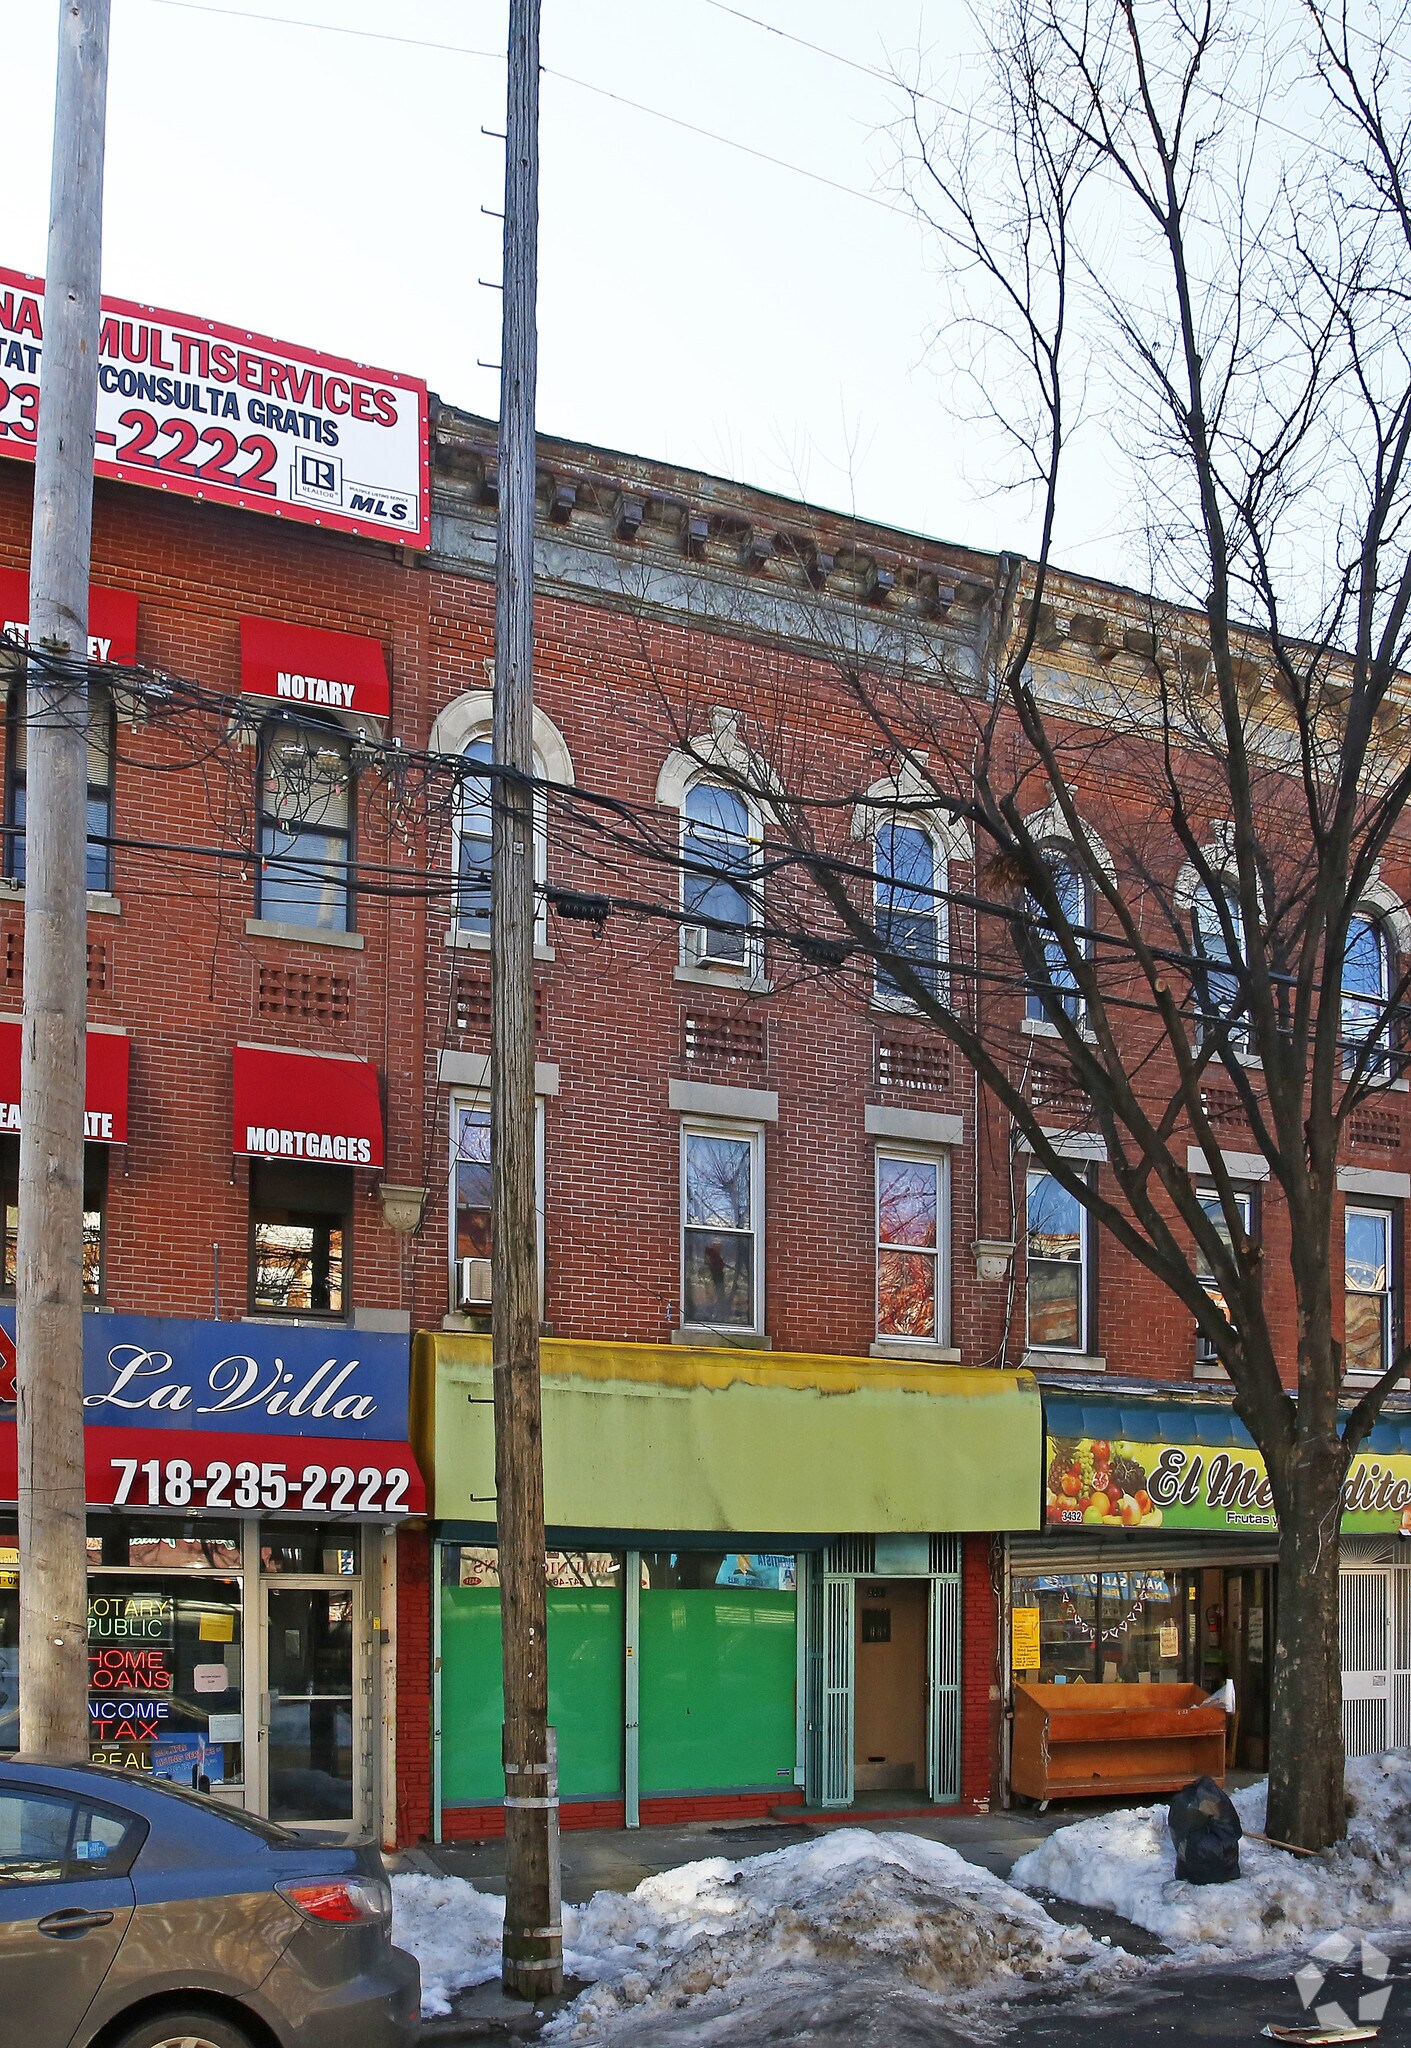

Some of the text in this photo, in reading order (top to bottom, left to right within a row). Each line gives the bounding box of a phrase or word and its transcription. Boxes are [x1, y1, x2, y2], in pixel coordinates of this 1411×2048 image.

[99, 317, 399, 428] MULTISERVICES
[99, 364, 241, 422] CONSULTA
[247, 399, 340, 447] GRATIS
[302, 485, 335, 499] REALTOR
[371, 491, 389, 499] LISTING
[390, 495, 409, 503] SERVICE
[349, 493, 409, 520] MLS
[277, 671, 355, 708] NOTARY
[246, 1125, 372, 1164] MORTGAGES
[83, 1343, 378, 1421] La Villa
[110, 1458, 411, 1513] 718-235-2222
[1146, 1448, 1204, 1508] El
[1061, 1510, 1083, 1523] 3432
[1226, 1511, 1270, 1525] Frutas
[87, 1617, 163, 1638] PUBLIC
[88, 1669, 171, 1689] OANS
[88, 1702, 169, 1719] NCOME
[91, 1720, 159, 1740] TAX
